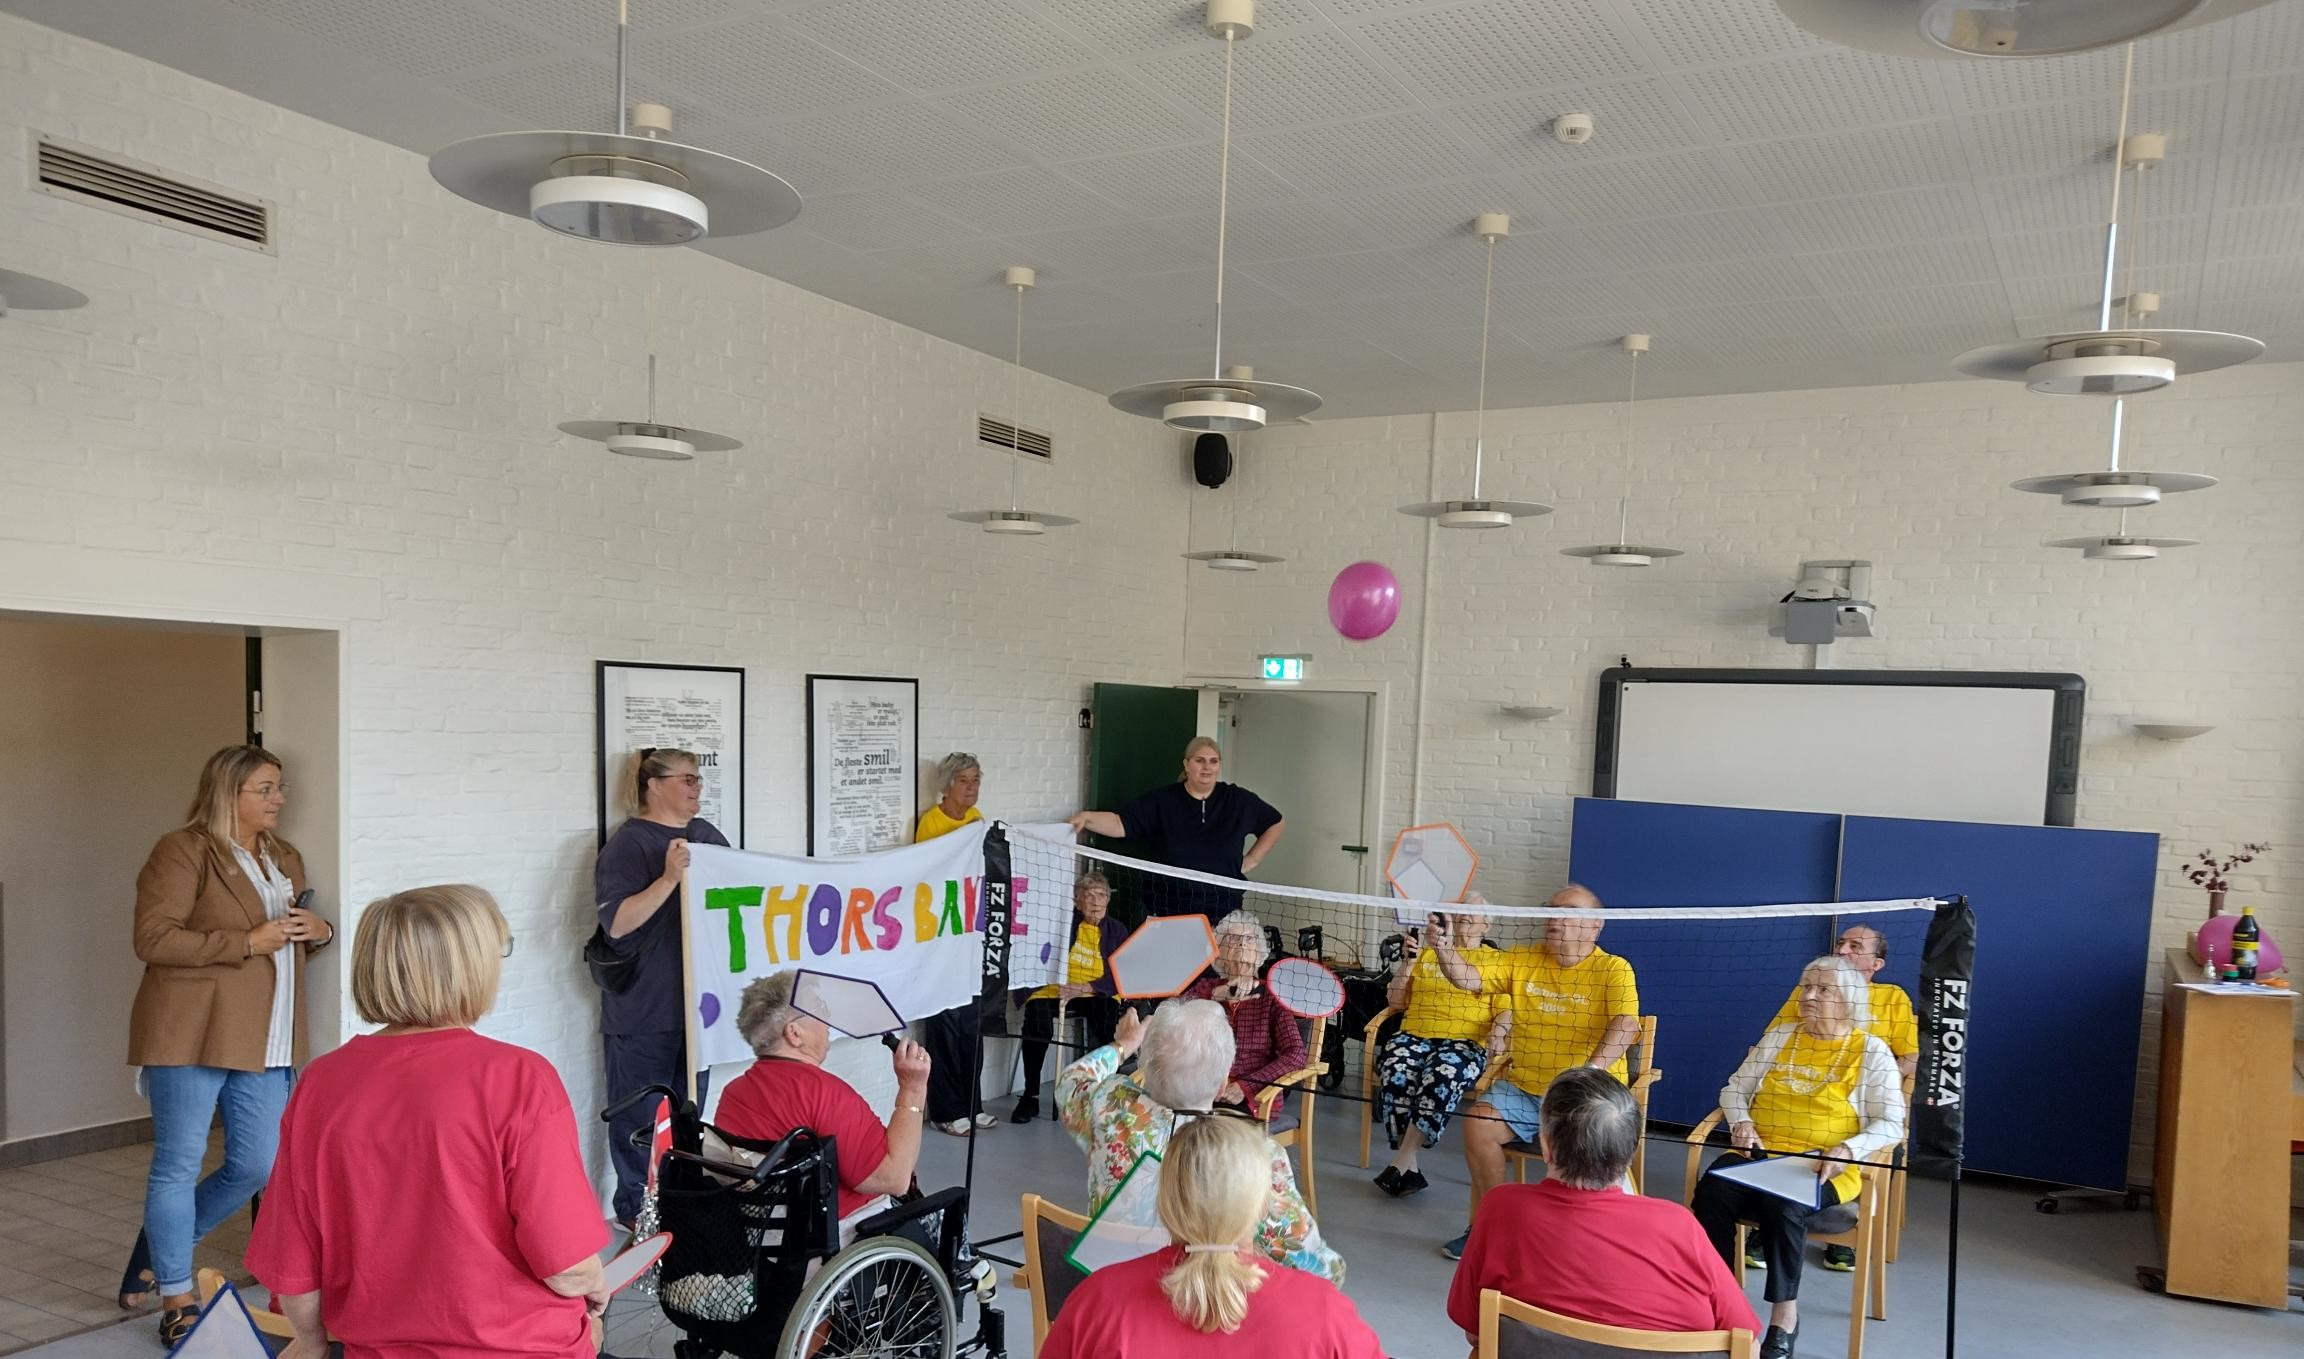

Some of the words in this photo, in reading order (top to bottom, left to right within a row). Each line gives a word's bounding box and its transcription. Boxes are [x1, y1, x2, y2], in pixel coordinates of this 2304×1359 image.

[834, 758, 844, 767] De
[863, 749, 890, 766] smil
[888, 765, 902, 774] med
[848, 776, 867, 786] andet
[991, 883, 1005, 906] FZ
[705, 883, 904, 974] THORS
[914, 877, 1029, 943] BAKE
[986, 911, 1005, 977] FORZA
[1932, 978, 1941, 1030] INNOVATED
[1943, 979, 1968, 1010] FZ
[1932, 1035, 1939, 1044] IN
[1928, 1050, 1940, 1093] DENMARK
[1937, 1017, 1965, 1107] FORZA
